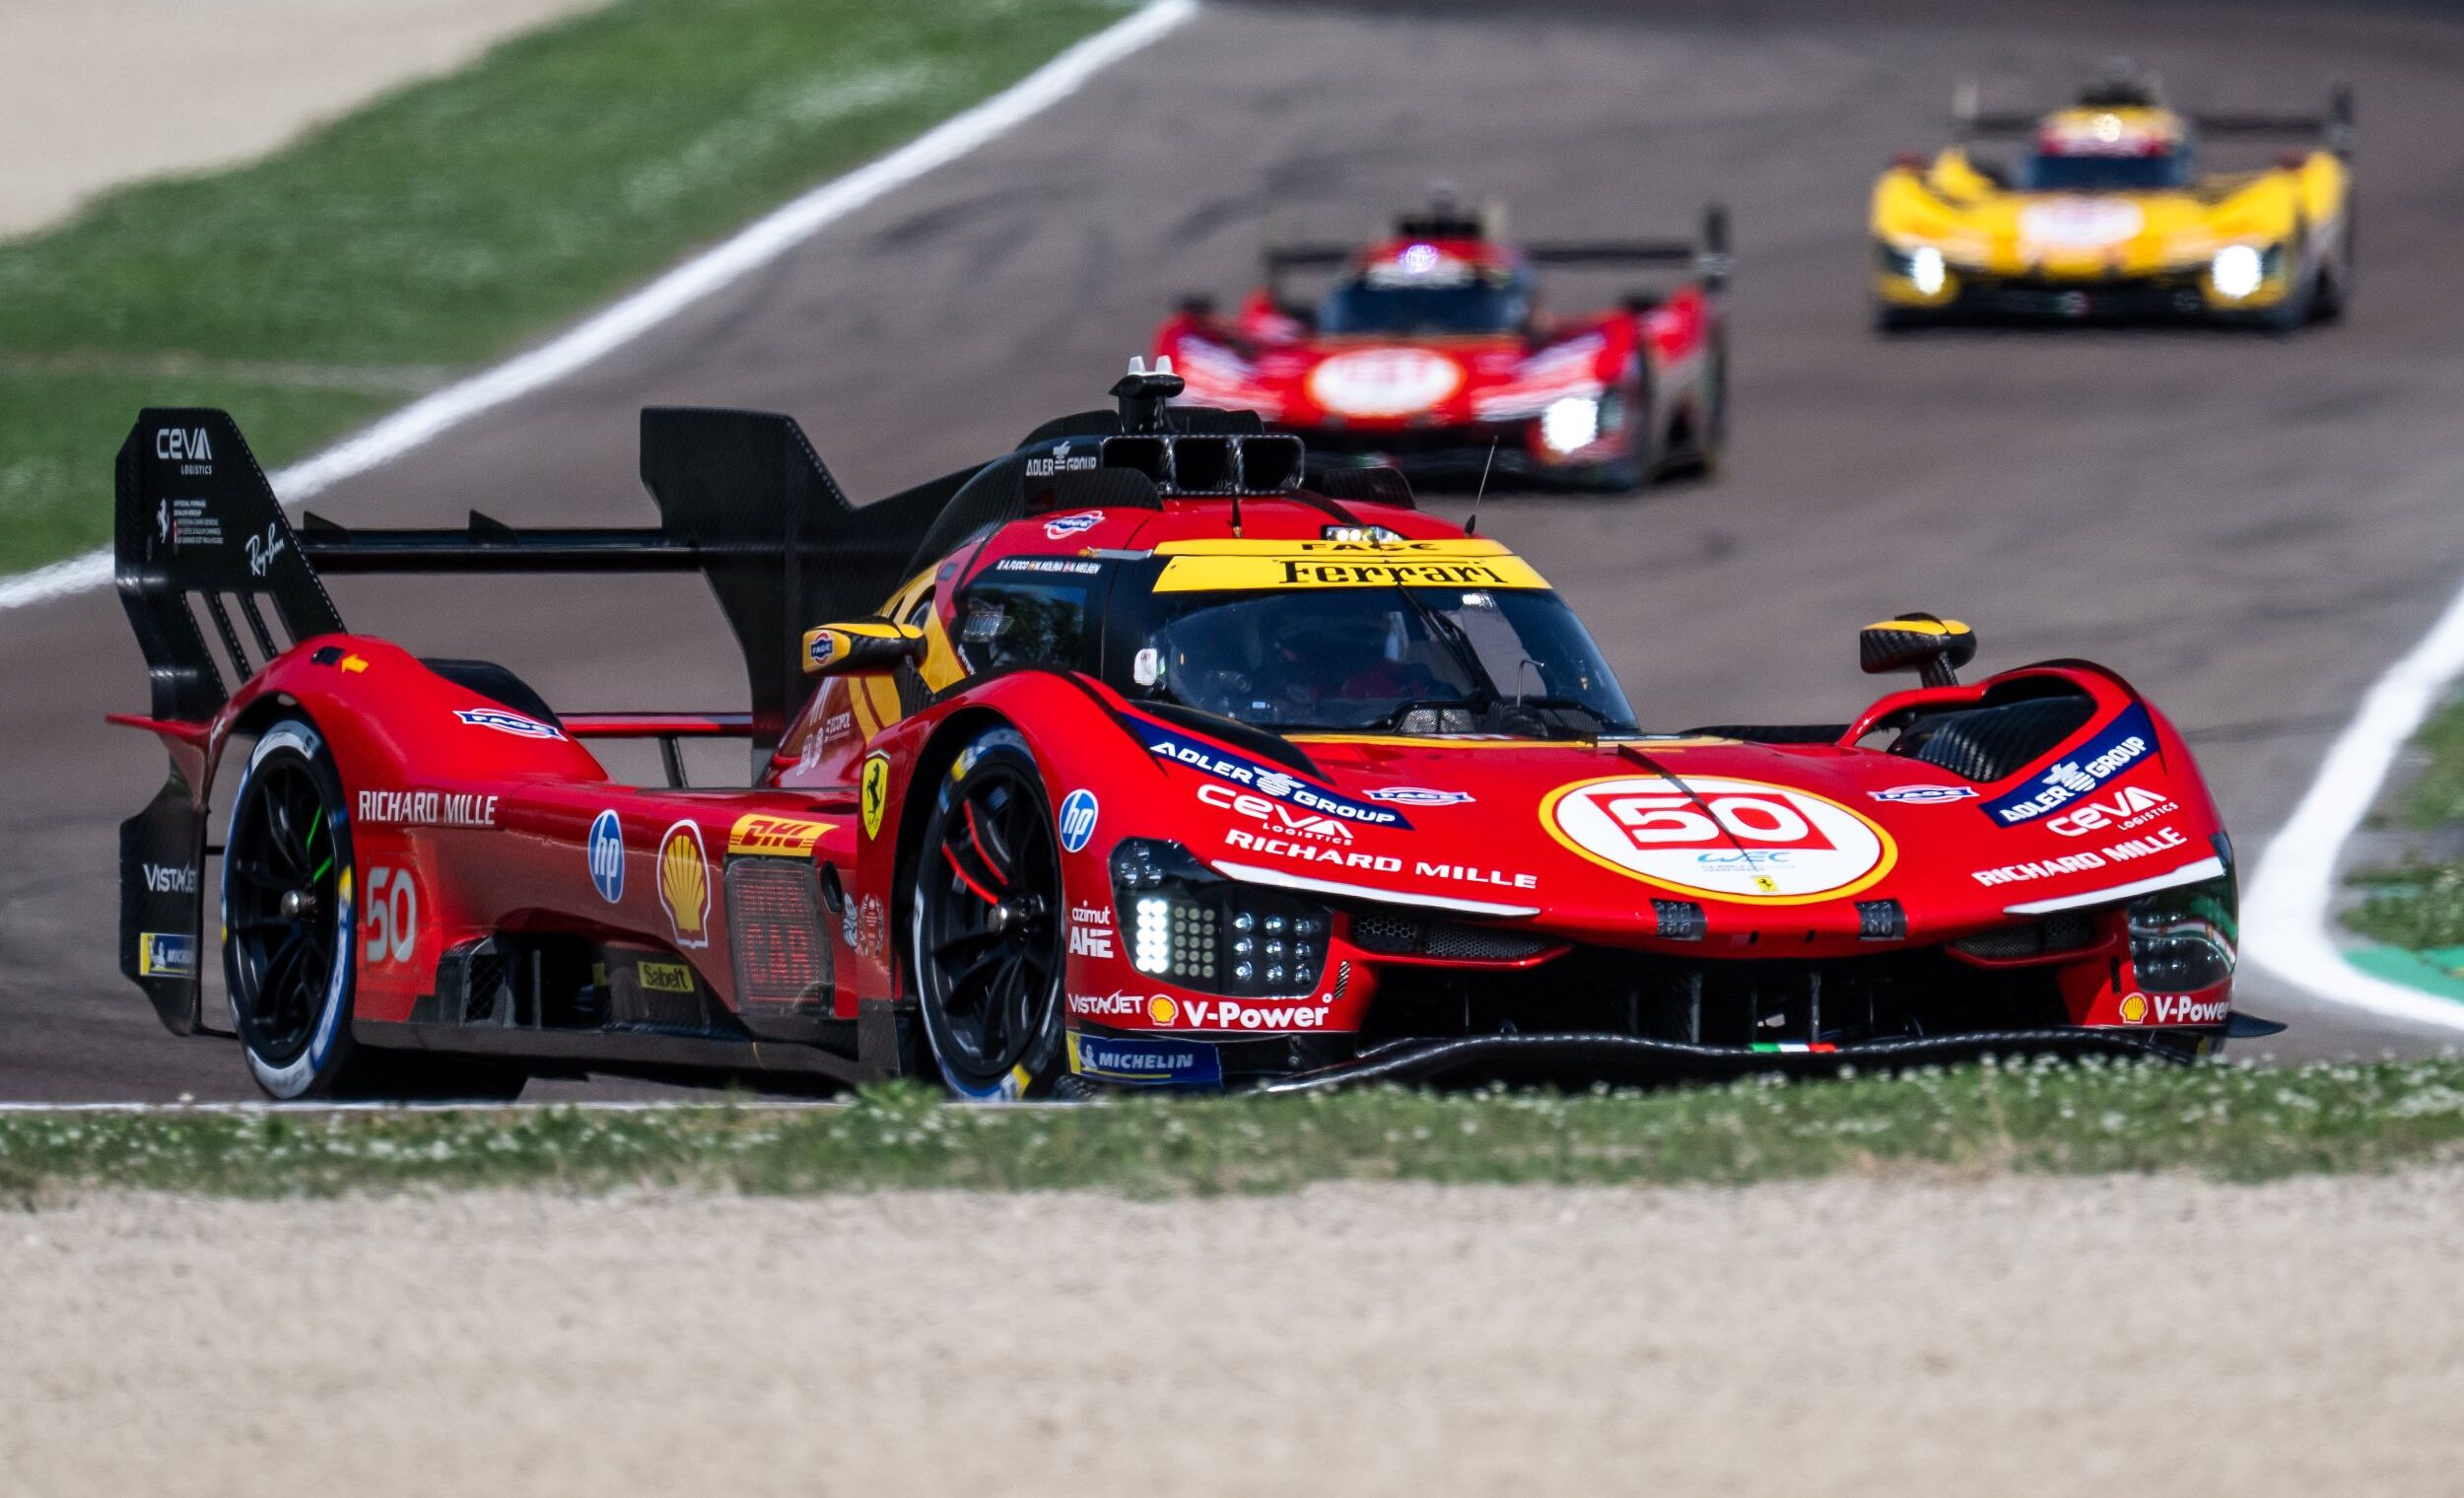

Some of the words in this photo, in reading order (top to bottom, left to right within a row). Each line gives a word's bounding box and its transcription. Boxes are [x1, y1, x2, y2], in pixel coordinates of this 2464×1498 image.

[180, 464, 213, 475] LOGISTICS
[1026, 458, 1054, 476] ADLER
[1279, 560, 1509, 583] Ferrari
[1149, 741, 1254, 784] ADLER
[1292, 789, 1397, 824] GROUP
[1999, 785, 2076, 822] ADLER
[2085, 736, 2147, 778] GROUP
[358, 790, 439, 822] RICHARD
[444, 793, 499, 825] MILLE
[1062, 789, 1095, 851] hp
[1608, 797, 1809, 844] 50
[2117, 801, 2179, 831] LOGISTICS
[740, 819, 815, 849] DHL
[1263, 822, 1353, 847] LOGISTICS
[593, 811, 620, 901] hp
[1224, 828, 1403, 873] RICHARD
[1415, 861, 1538, 890] MILLE
[1971, 851, 2107, 887] RICHARD
[2100, 826, 2188, 862] MILLE
[366, 866, 417, 963] 50
[1071, 899, 1112, 925] azimut
[1068, 925, 1115, 959] AHE
[1067, 988, 1144, 1016] VISTAJET
[1183, 1000, 1330, 1029] V-Power
[1098, 1053, 1195, 1069] MICHELIN
